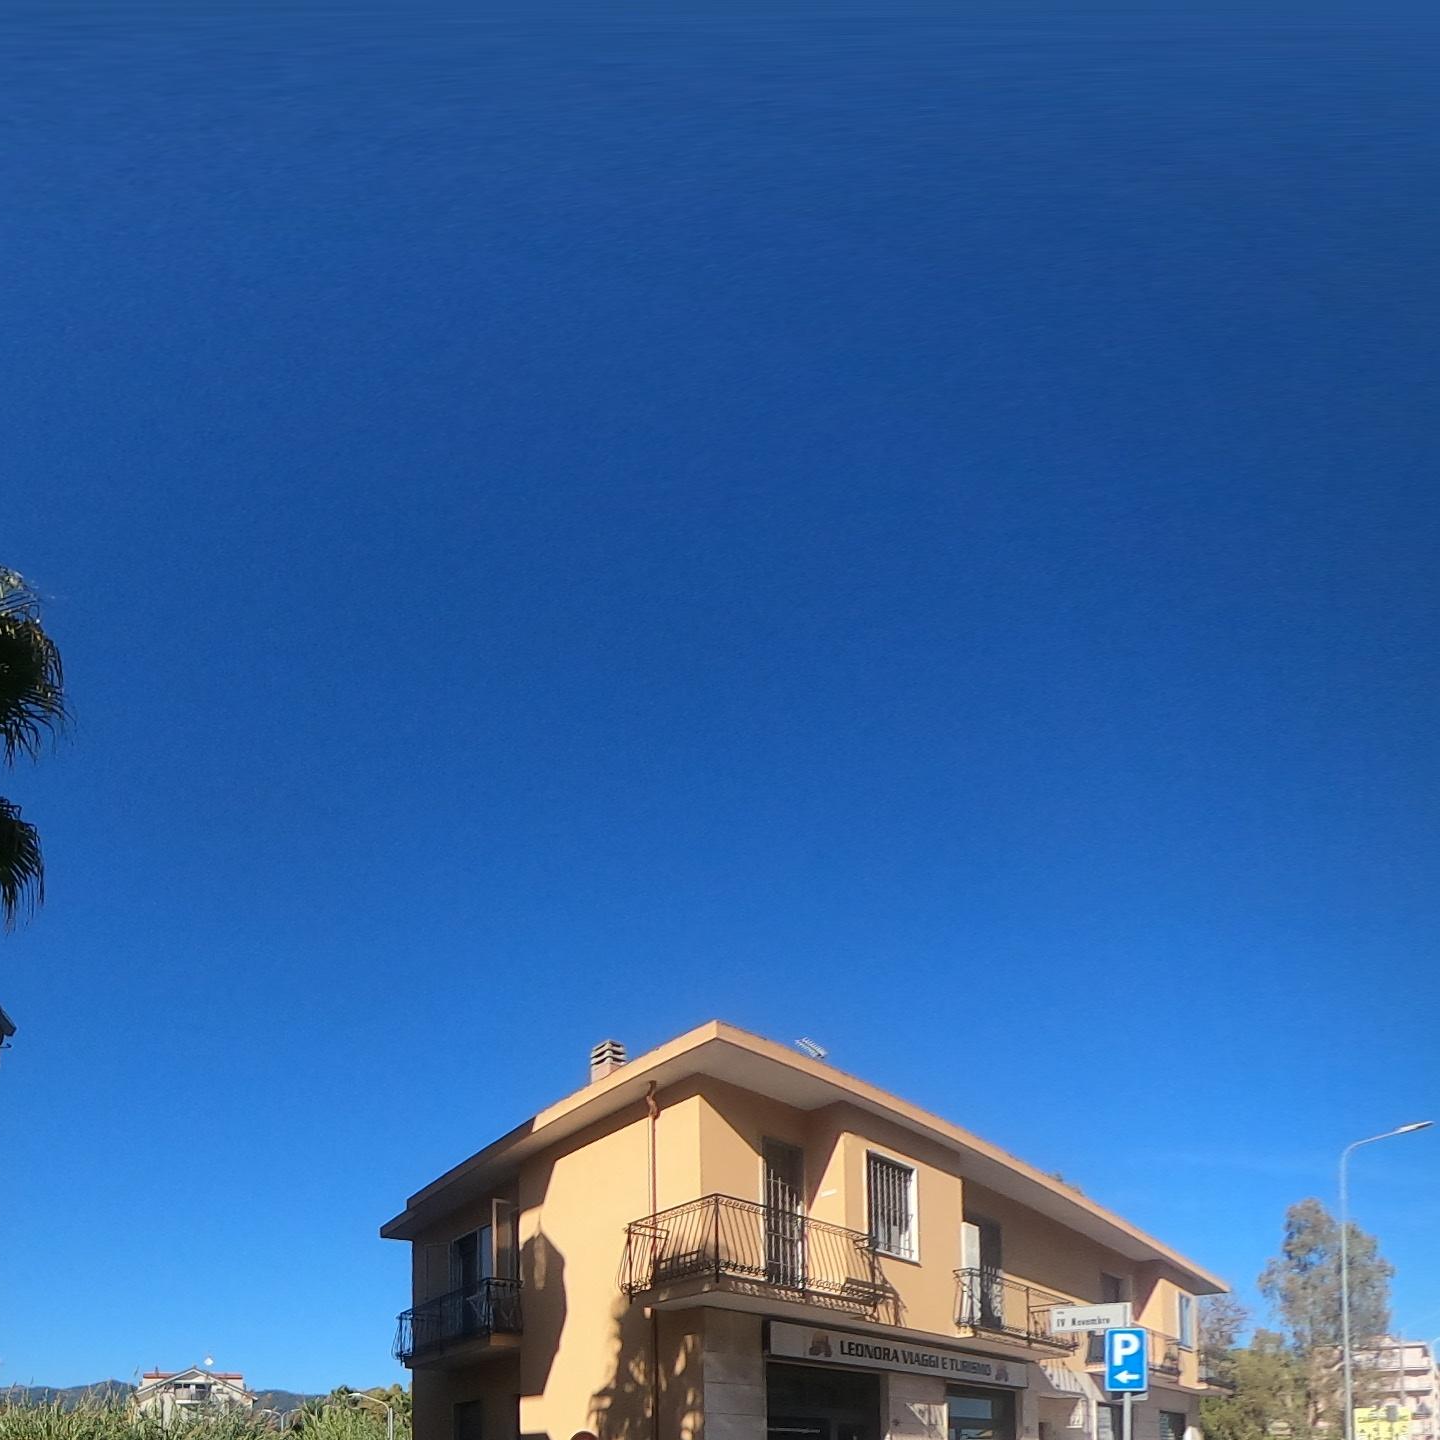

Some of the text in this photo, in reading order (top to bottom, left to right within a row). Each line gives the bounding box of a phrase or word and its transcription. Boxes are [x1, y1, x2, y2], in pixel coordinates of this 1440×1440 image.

[1071, 1316, 1111, 1326] Novembre
[840, 1340, 992, 1377] LEONORA VIAGGI E TURISMO
[1112, 1333, 1140, 1367] P
